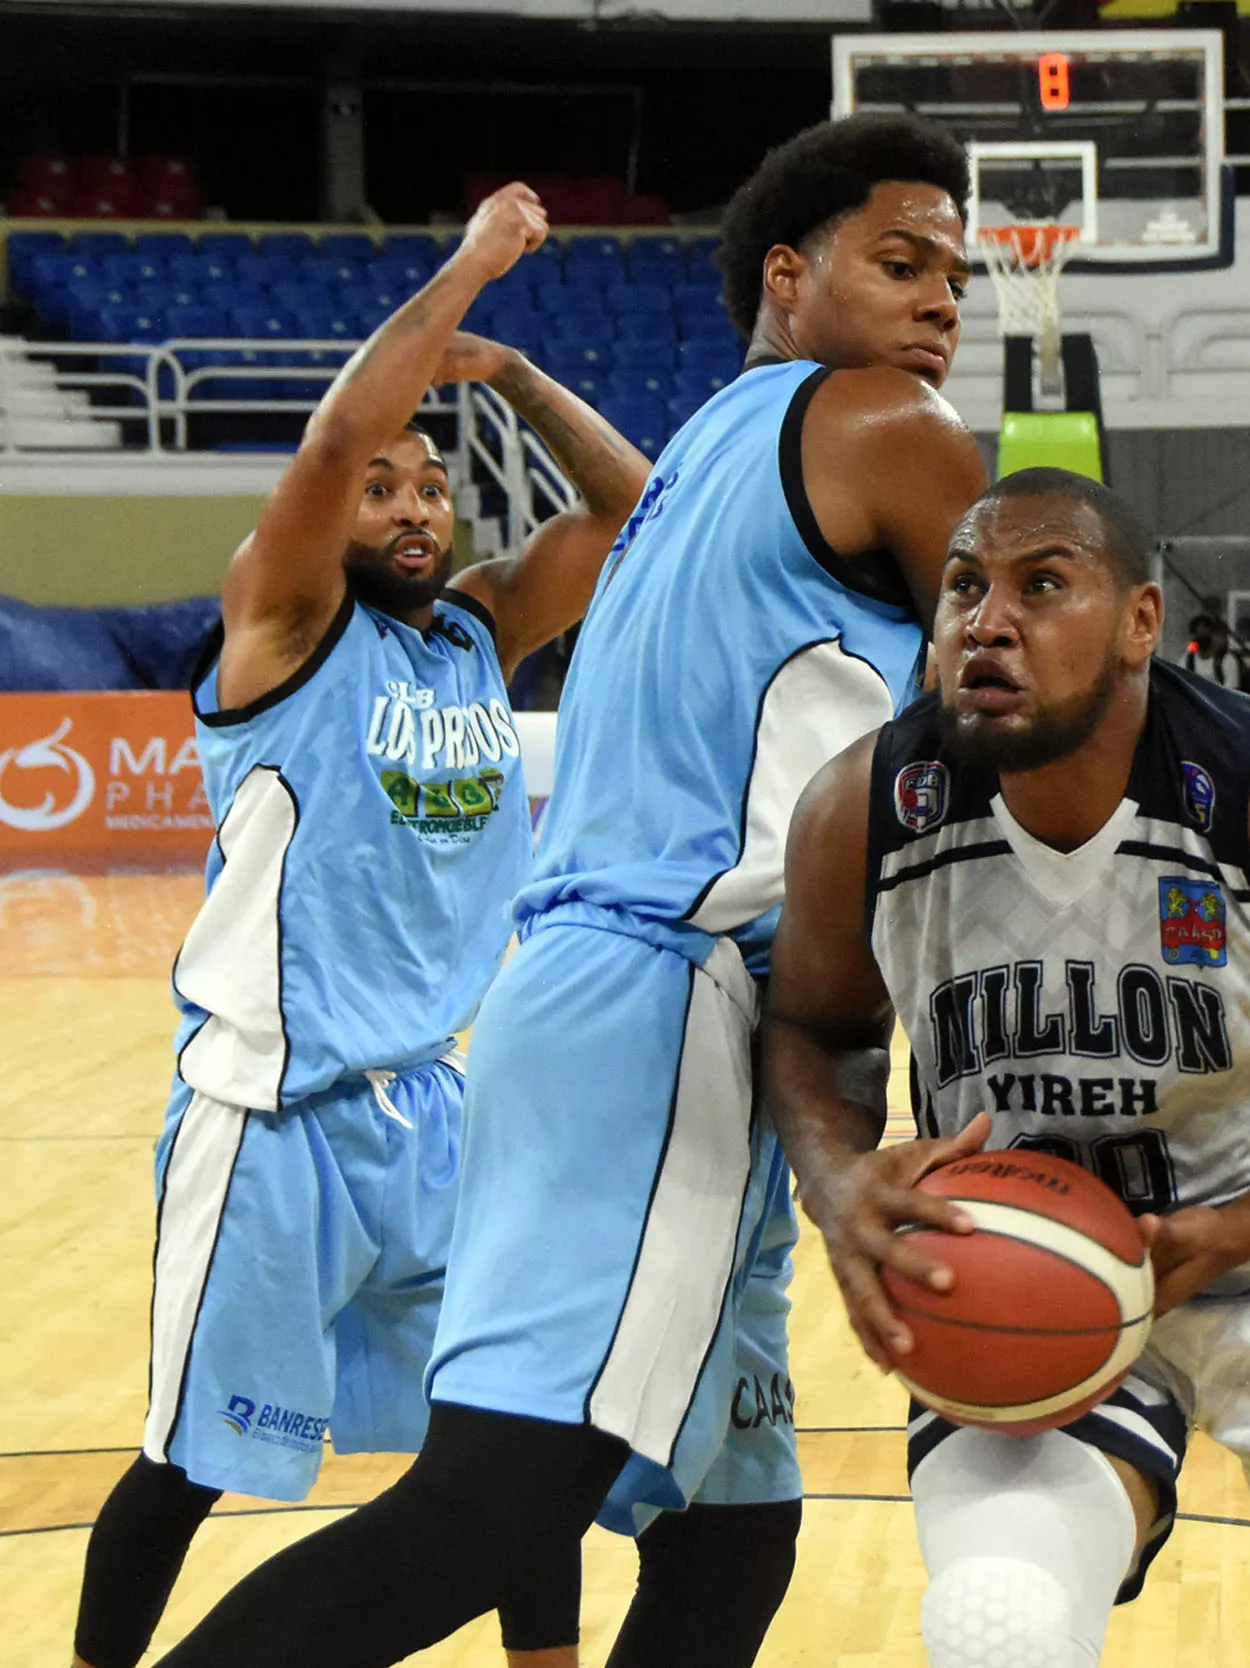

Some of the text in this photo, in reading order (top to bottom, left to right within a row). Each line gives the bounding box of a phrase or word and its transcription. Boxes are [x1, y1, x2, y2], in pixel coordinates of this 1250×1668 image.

[1038, 51, 1070, 110] 8
[109, 737, 201, 775] MA
[986, 1073, 1159, 1117] YIREH
